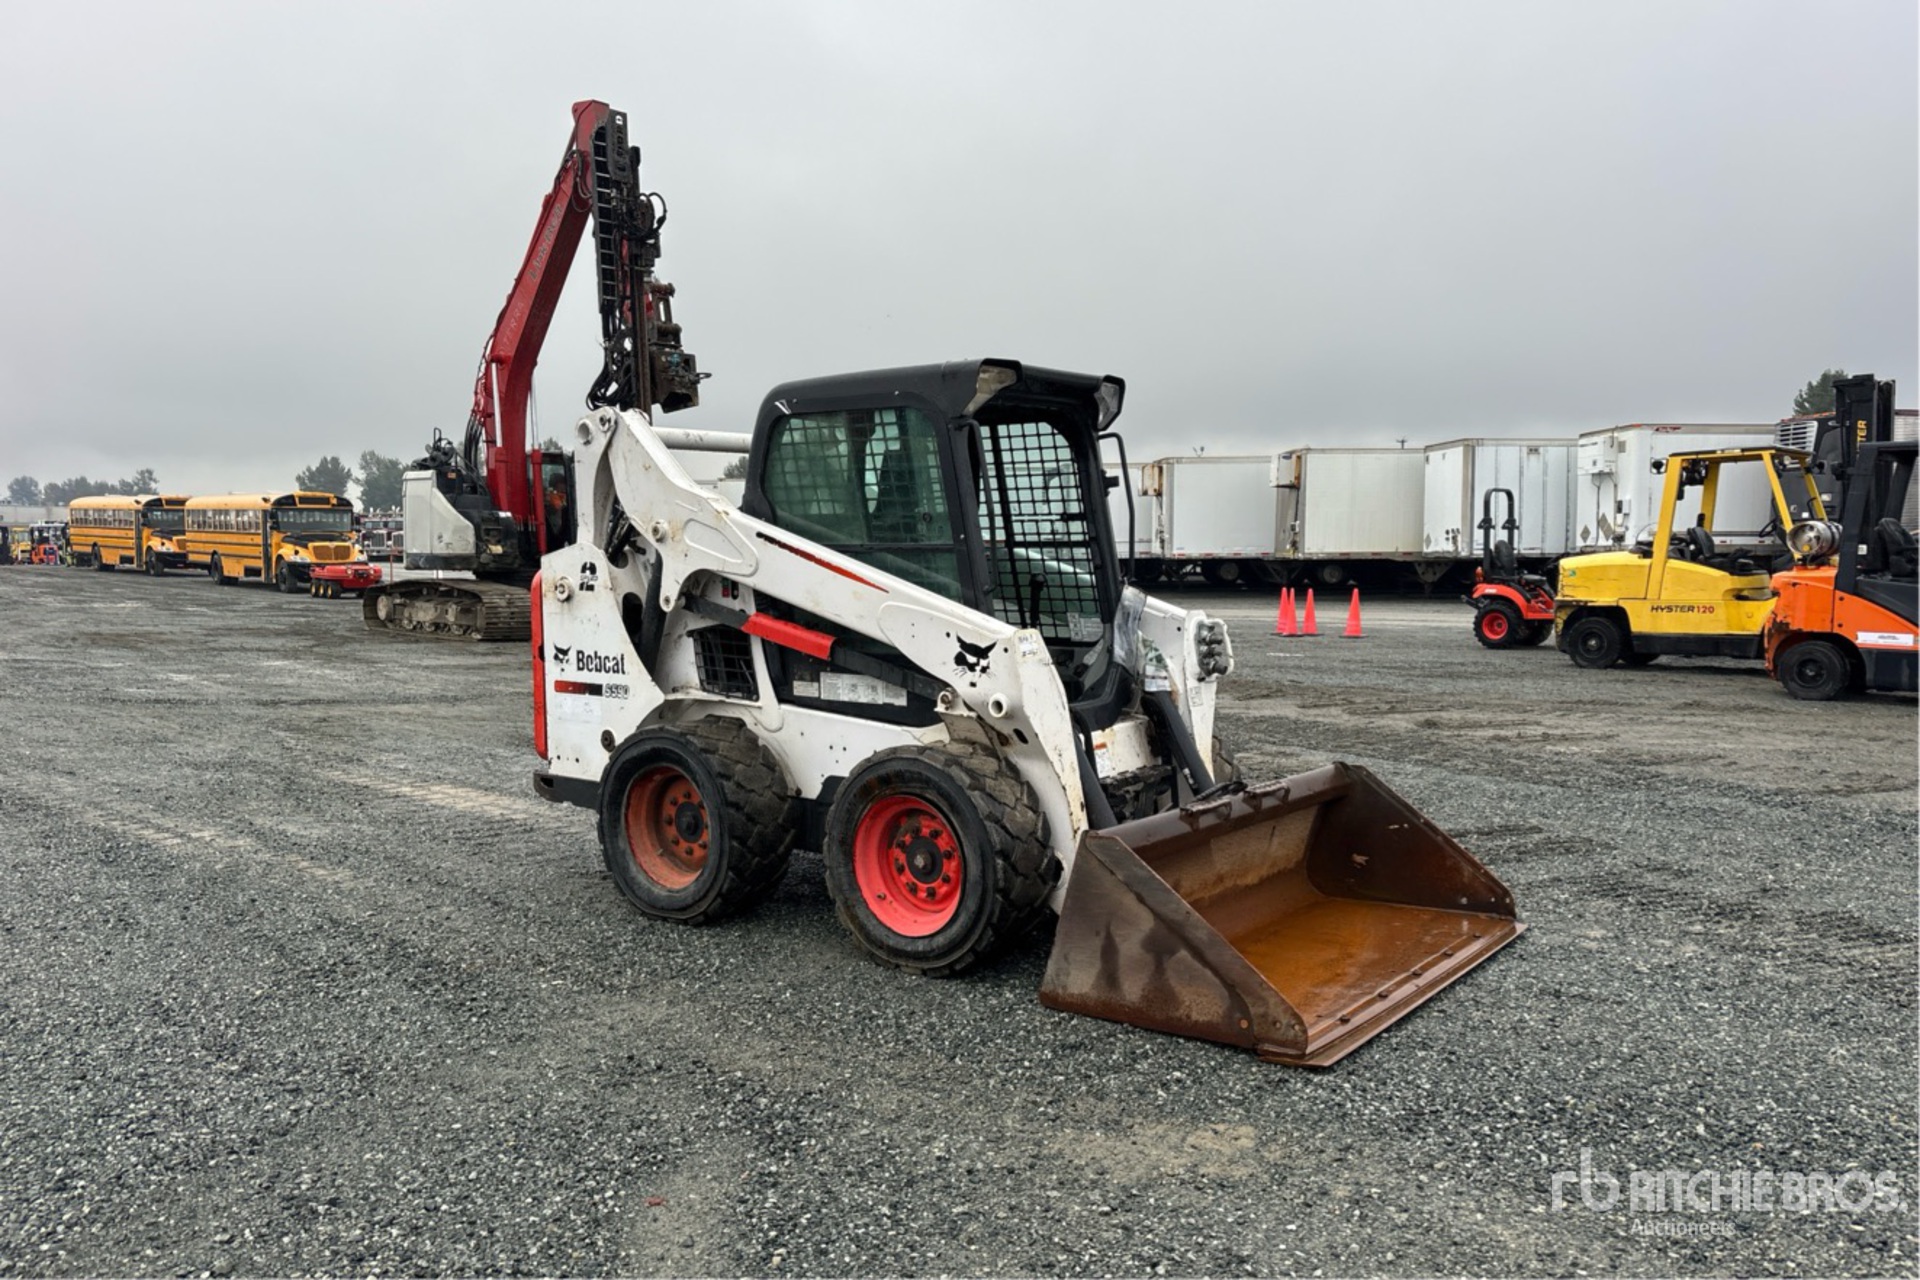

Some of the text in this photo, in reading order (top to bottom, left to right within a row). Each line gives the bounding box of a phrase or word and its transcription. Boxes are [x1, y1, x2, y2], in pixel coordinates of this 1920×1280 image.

[1650, 604, 1715, 614] HYSTER 120
[576, 650, 626, 675] Bobcat
